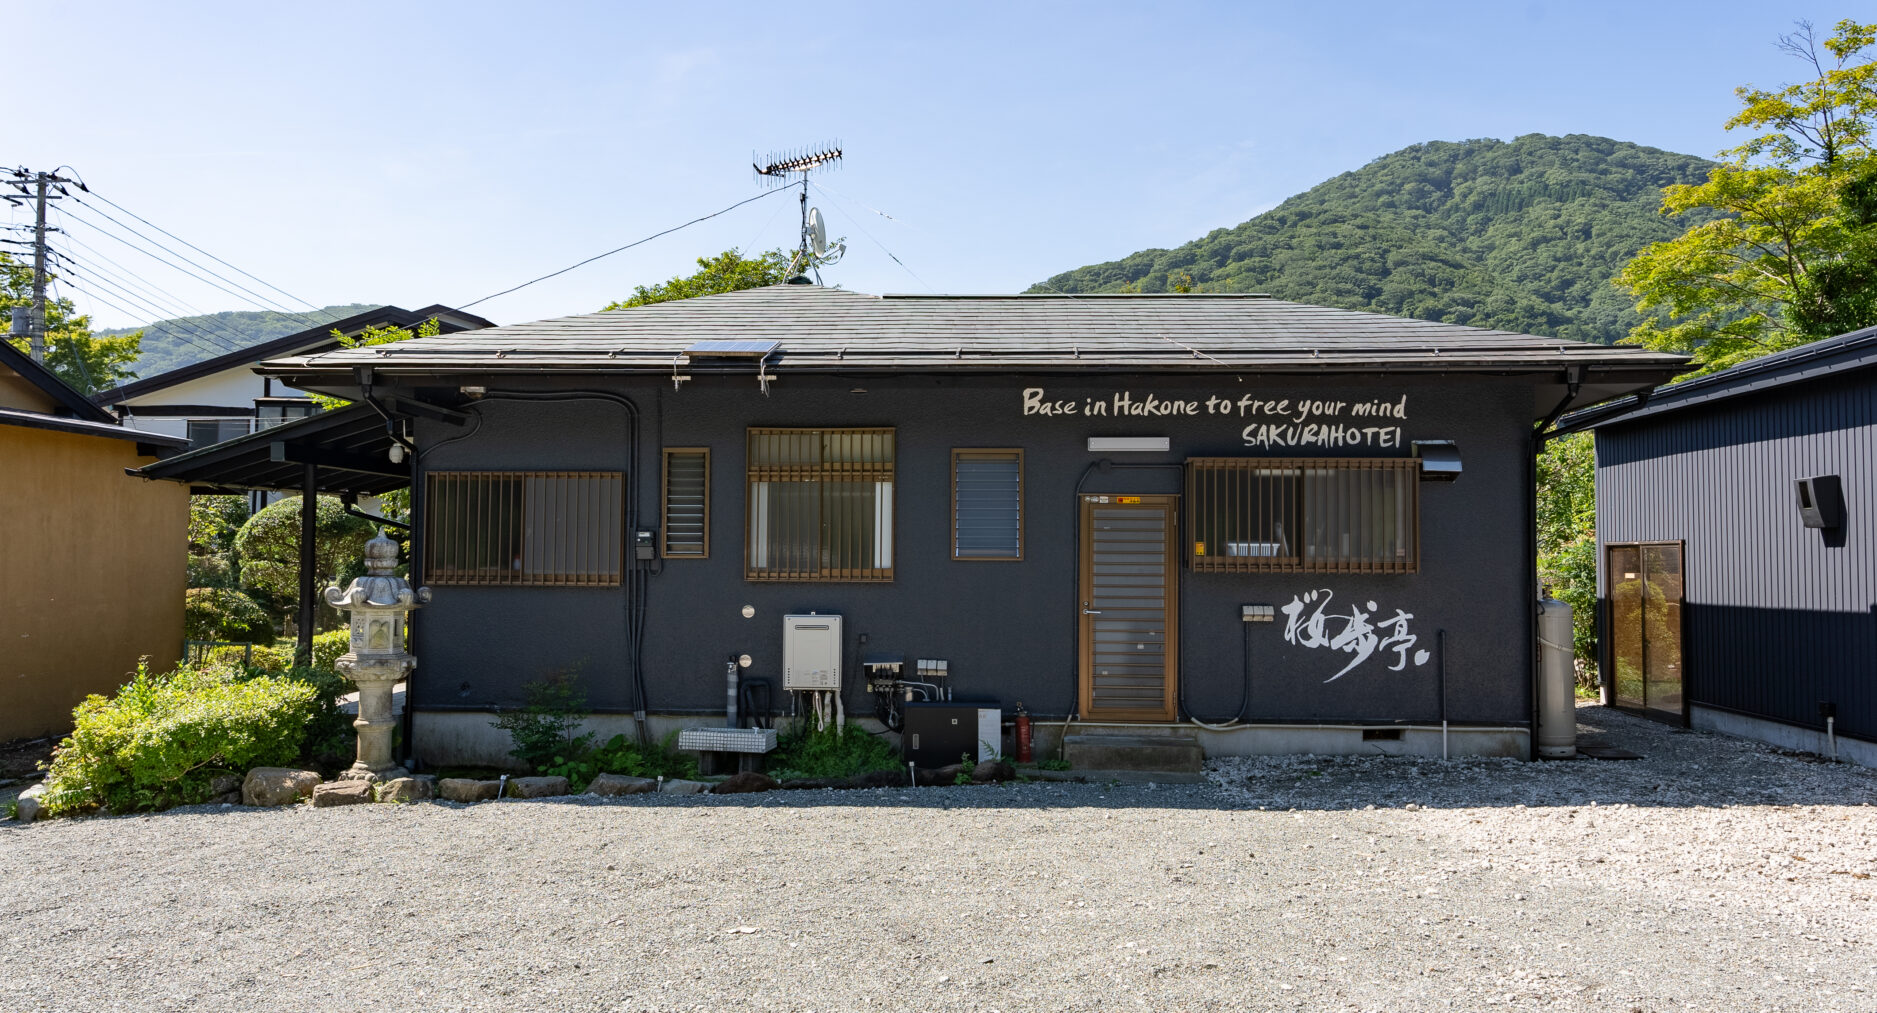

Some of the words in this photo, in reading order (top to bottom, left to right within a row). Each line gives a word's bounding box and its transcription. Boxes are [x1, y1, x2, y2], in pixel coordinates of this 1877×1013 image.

[1023, 388, 1077, 416] Base
[1085, 397, 1106, 416] in
[1113, 392, 1199, 417] Hakone
[1206, 395, 1231, 415] to
[1237, 394, 1291, 417] free
[1293, 399, 1346, 423] your
[1351, 395, 1407, 419] mind
